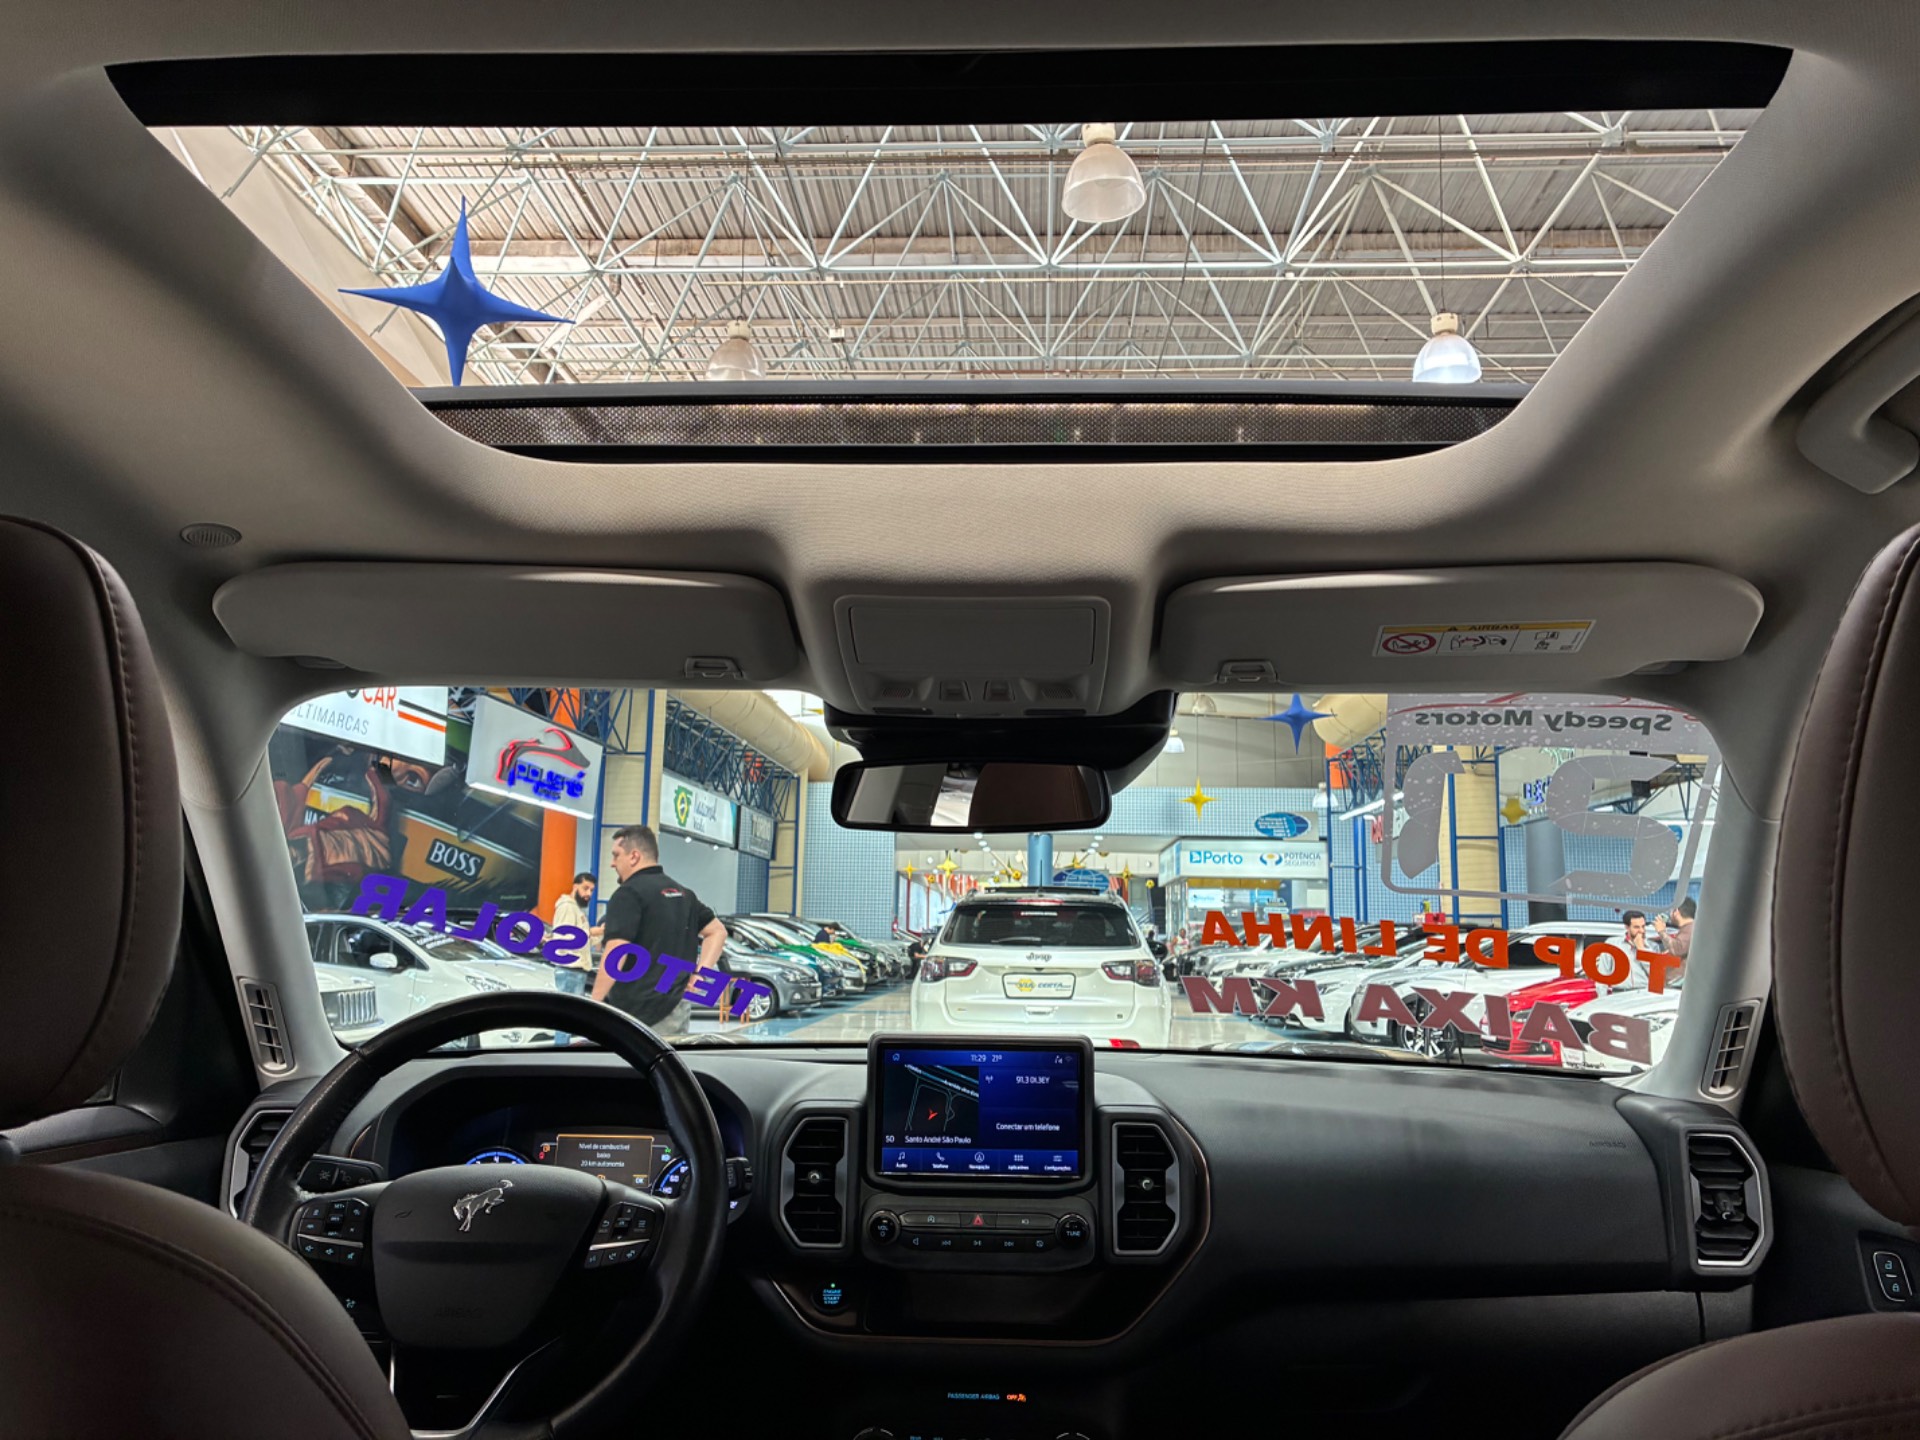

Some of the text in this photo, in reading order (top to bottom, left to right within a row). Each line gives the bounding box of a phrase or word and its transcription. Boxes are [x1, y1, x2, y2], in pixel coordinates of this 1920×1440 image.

[429, 841, 481, 878] BOSS
[1203, 850, 1244, 865] Porto
[996, 1122, 1023, 1131] Conectar
[1034, 1122, 1060, 1132] telefone
[904, 1135, 972, 1145] Santo André São Paulo
[596, 1151, 611, 1159] baixo
[947, 1392, 979, 1400] PASSENGER
[980, 1392, 1000, 1401] AIRBAG
